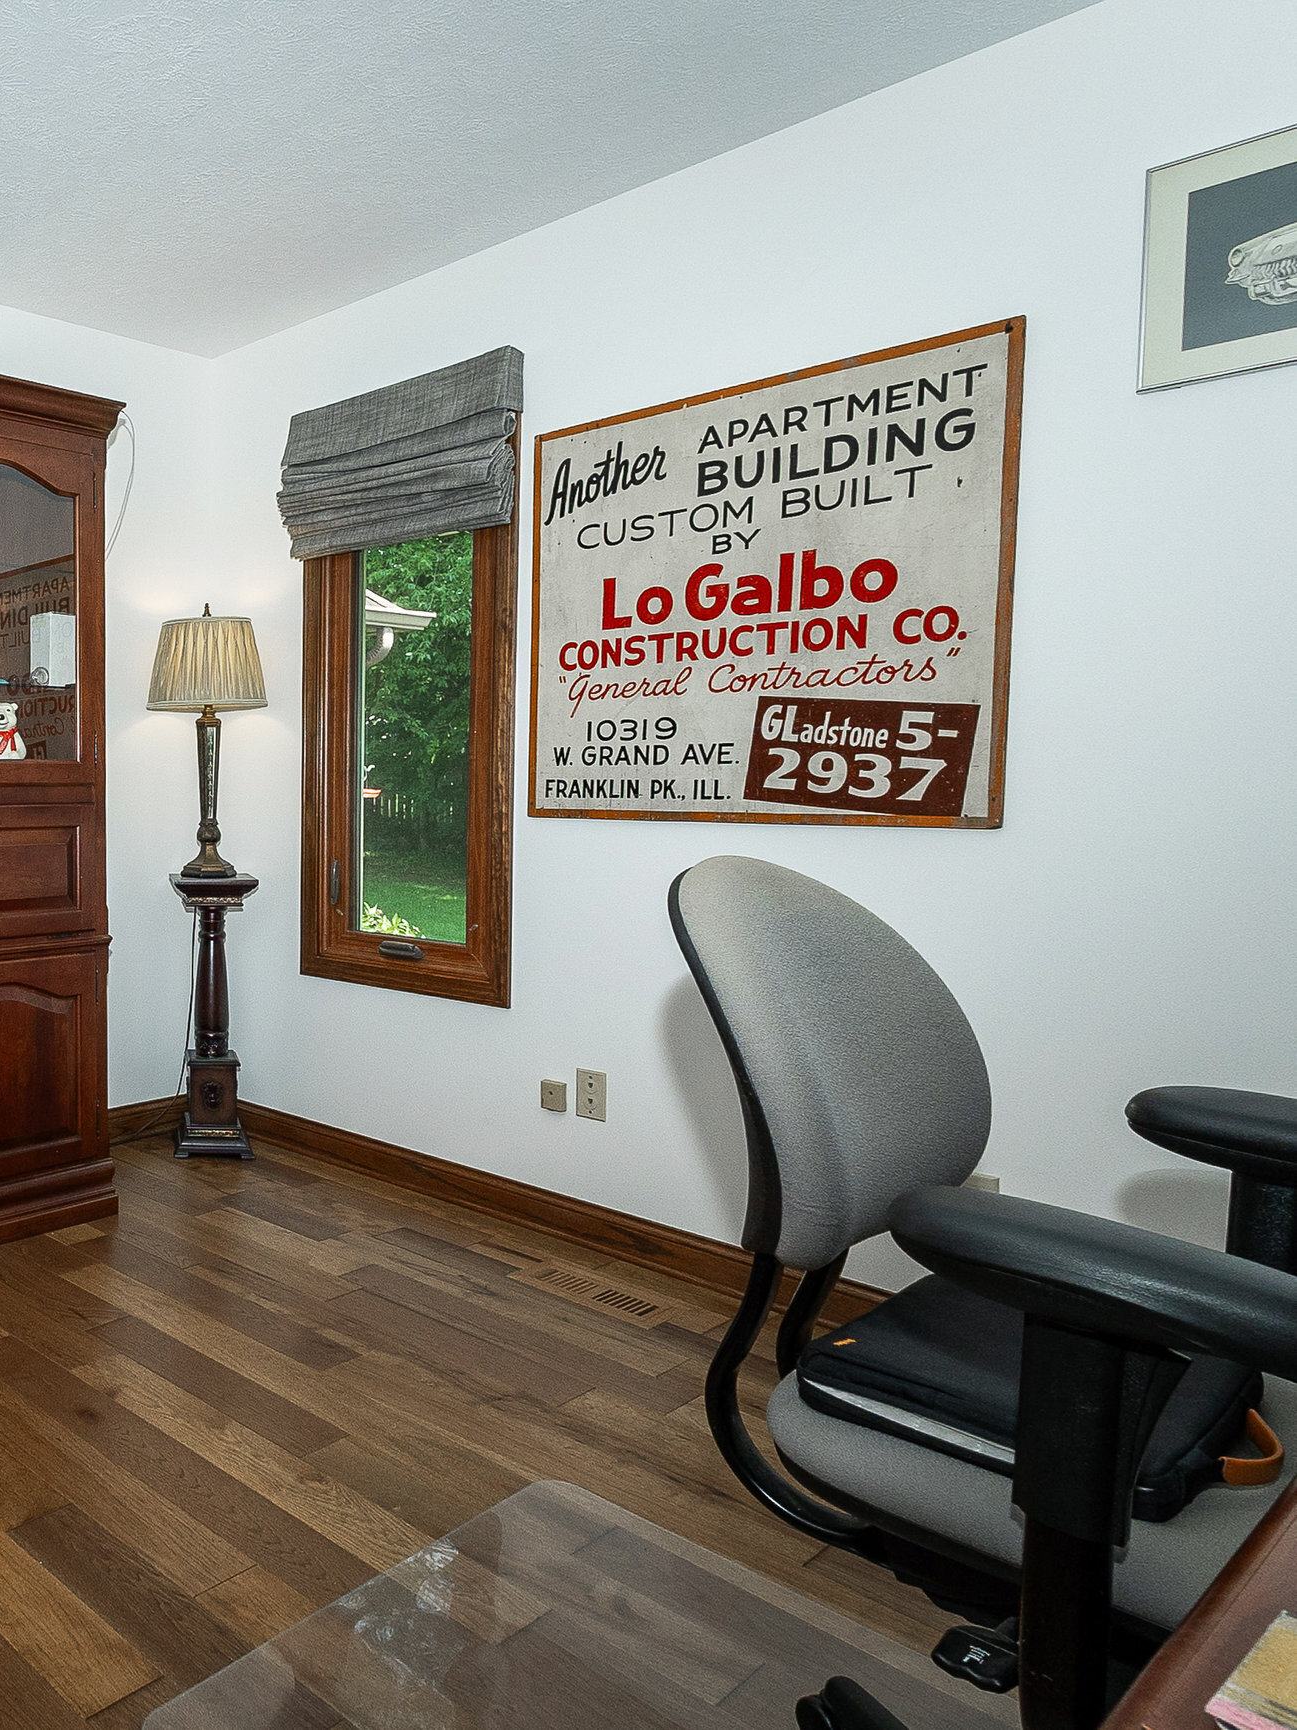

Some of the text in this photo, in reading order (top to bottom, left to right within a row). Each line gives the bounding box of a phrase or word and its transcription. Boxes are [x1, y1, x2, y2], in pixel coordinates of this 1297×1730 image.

[697, 363, 988, 454] APARTMENT
[544, 441, 667, 526] Another
[697, 408, 976, 497] BUILDING
[577, 464, 933, 549] CUSTOM BUILT
[711, 528, 762, 555] BY
[602, 549, 898, 631] Lo Galbo
[559, 606, 968, 671] CONSTRUCTION CO.
[559, 647, 961, 718] "General Contractors"
[553, 743, 740, 767] W. GRAND AVE.
[586, 716, 678, 742] 10319
[760, 704, 959, 751] GLadstone 5-
[545, 778, 731, 802] FRANKLIN PK., ILL.
[762, 747, 948, 802] 2937
